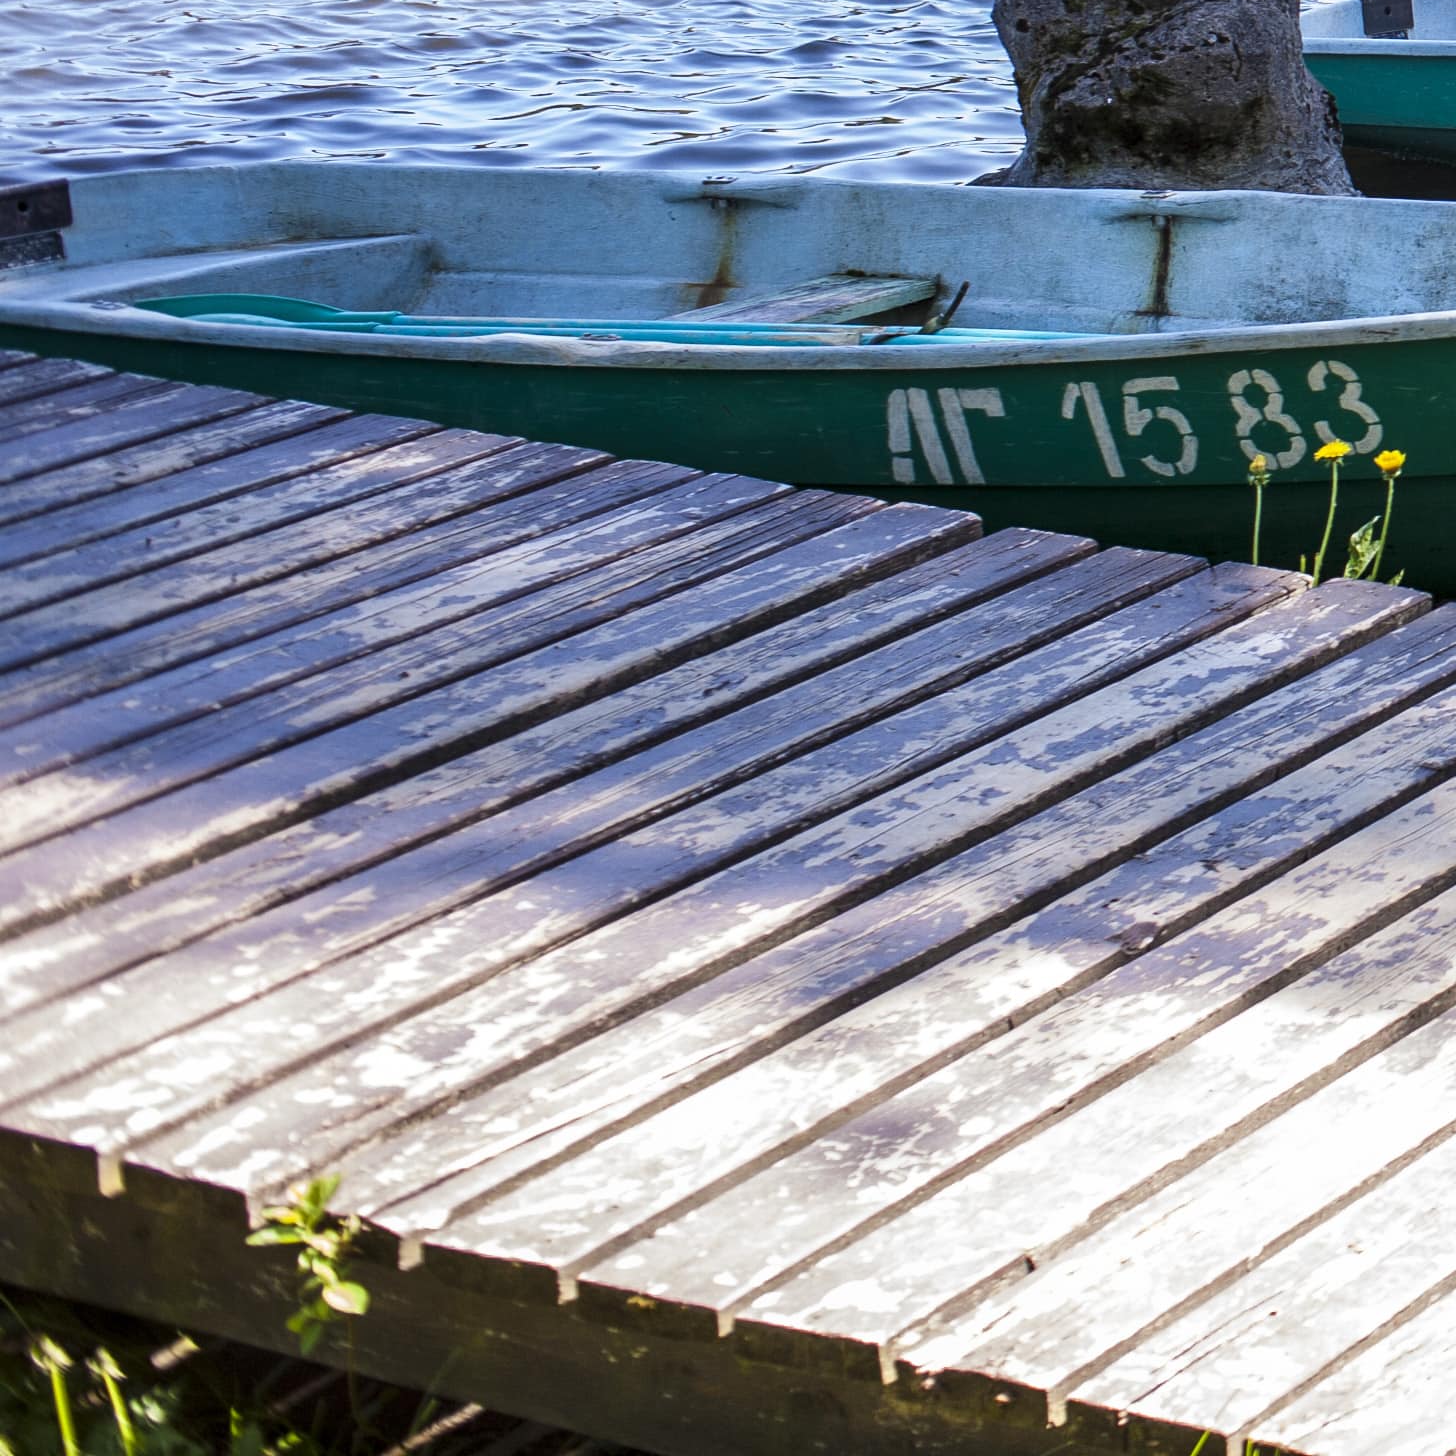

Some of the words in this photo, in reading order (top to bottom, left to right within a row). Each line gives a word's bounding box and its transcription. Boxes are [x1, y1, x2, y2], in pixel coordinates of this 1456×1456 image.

[887, 388, 1005, 485] ЛГ
[1061, 375, 1198, 478] 15
[1227, 360, 1383, 471] 83
